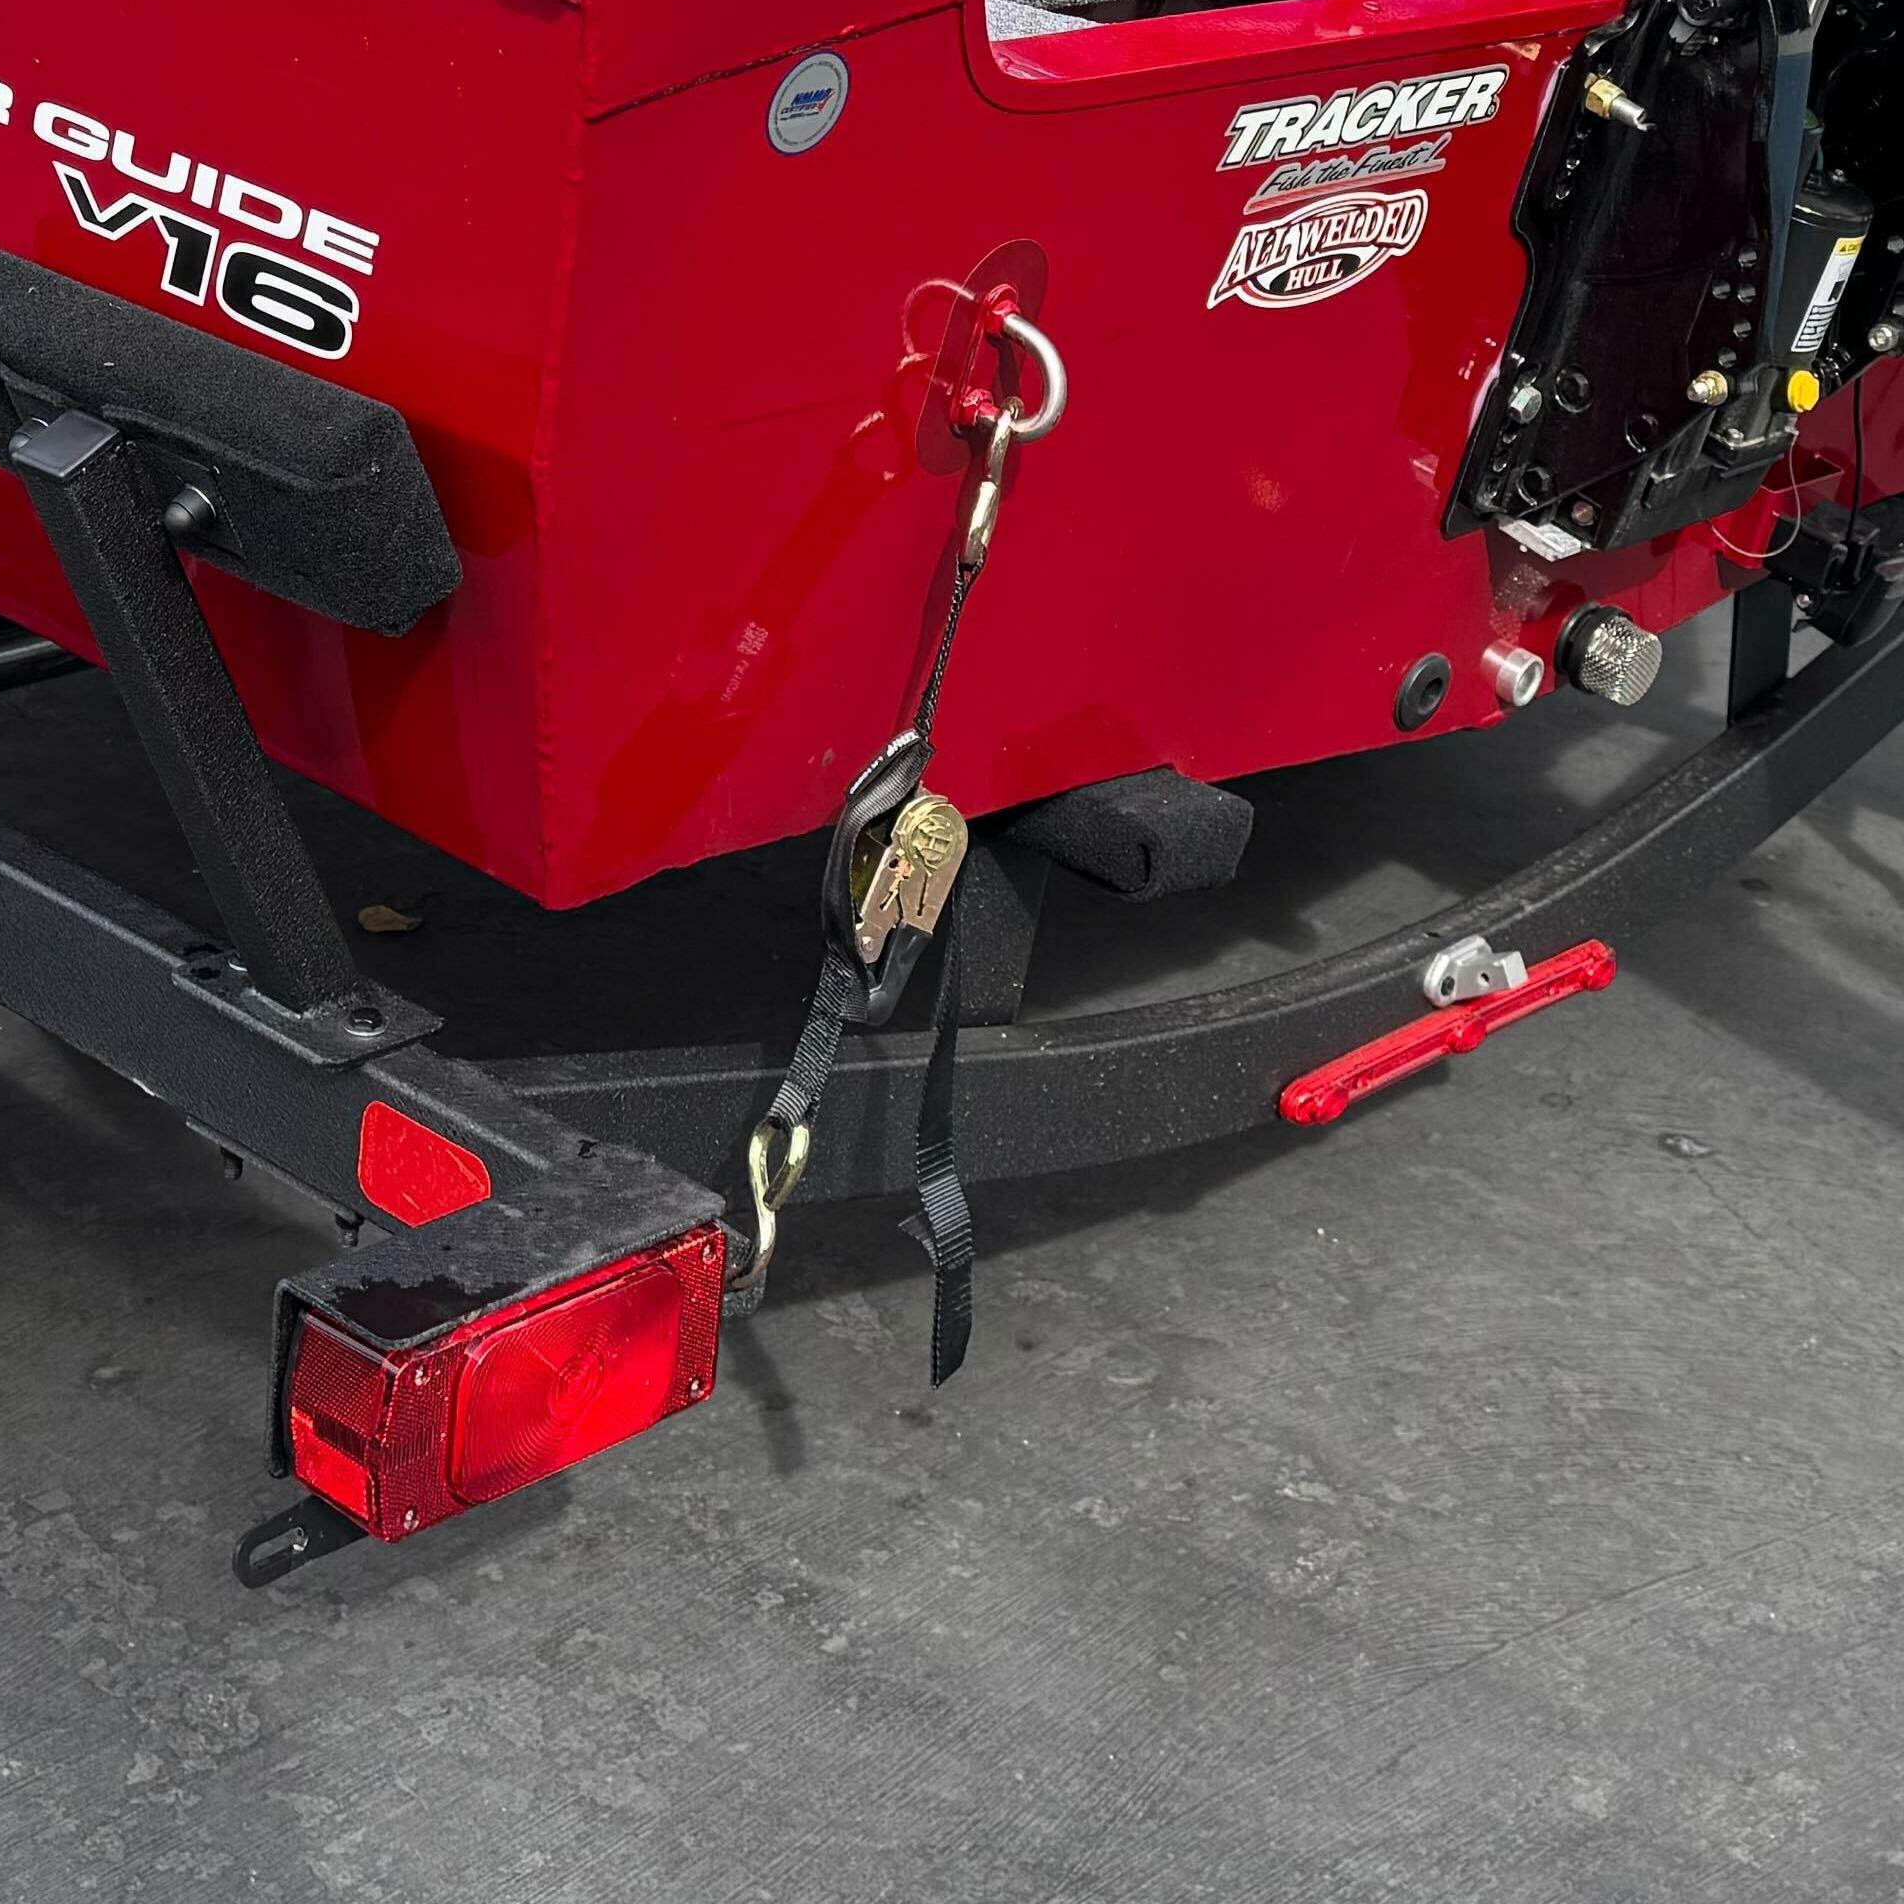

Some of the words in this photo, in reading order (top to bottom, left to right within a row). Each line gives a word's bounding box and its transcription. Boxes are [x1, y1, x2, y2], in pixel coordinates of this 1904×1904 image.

[1222, 67, 1507, 168] TRACKER
[33, 100, 380, 276] GUIDE
[52, 160, 361, 361] V16
[1284, 258, 1344, 292] HULL
